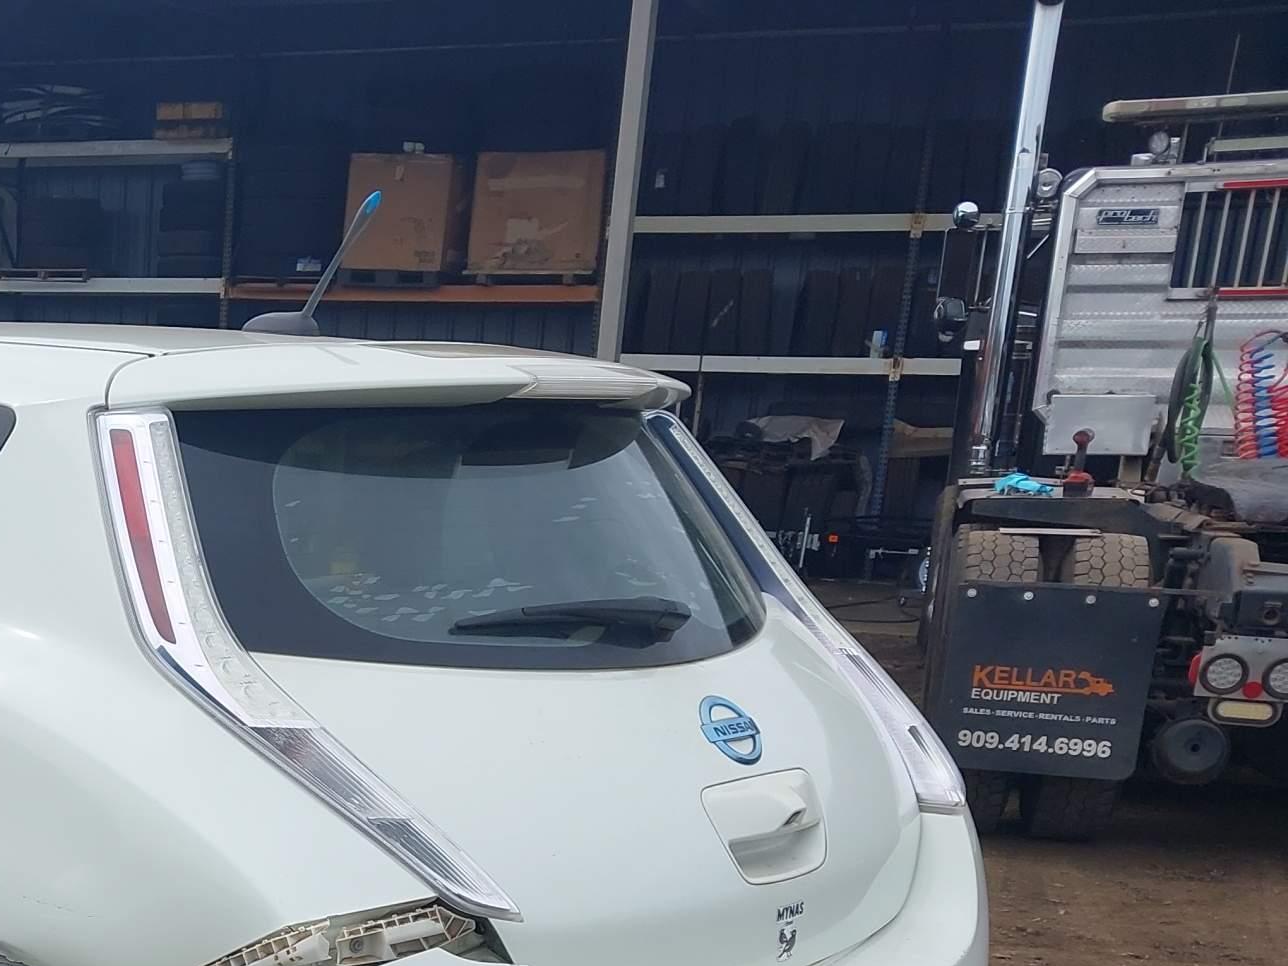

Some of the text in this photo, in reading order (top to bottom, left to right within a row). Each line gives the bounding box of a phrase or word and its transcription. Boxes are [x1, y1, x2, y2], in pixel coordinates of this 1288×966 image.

[972, 664, 1076, 689] KELLAR
[971, 688, 1062, 704] EQUIPMENT
[712, 719, 755, 738] NISSAN
[957, 729, 1112, 758] 909.414.6996
